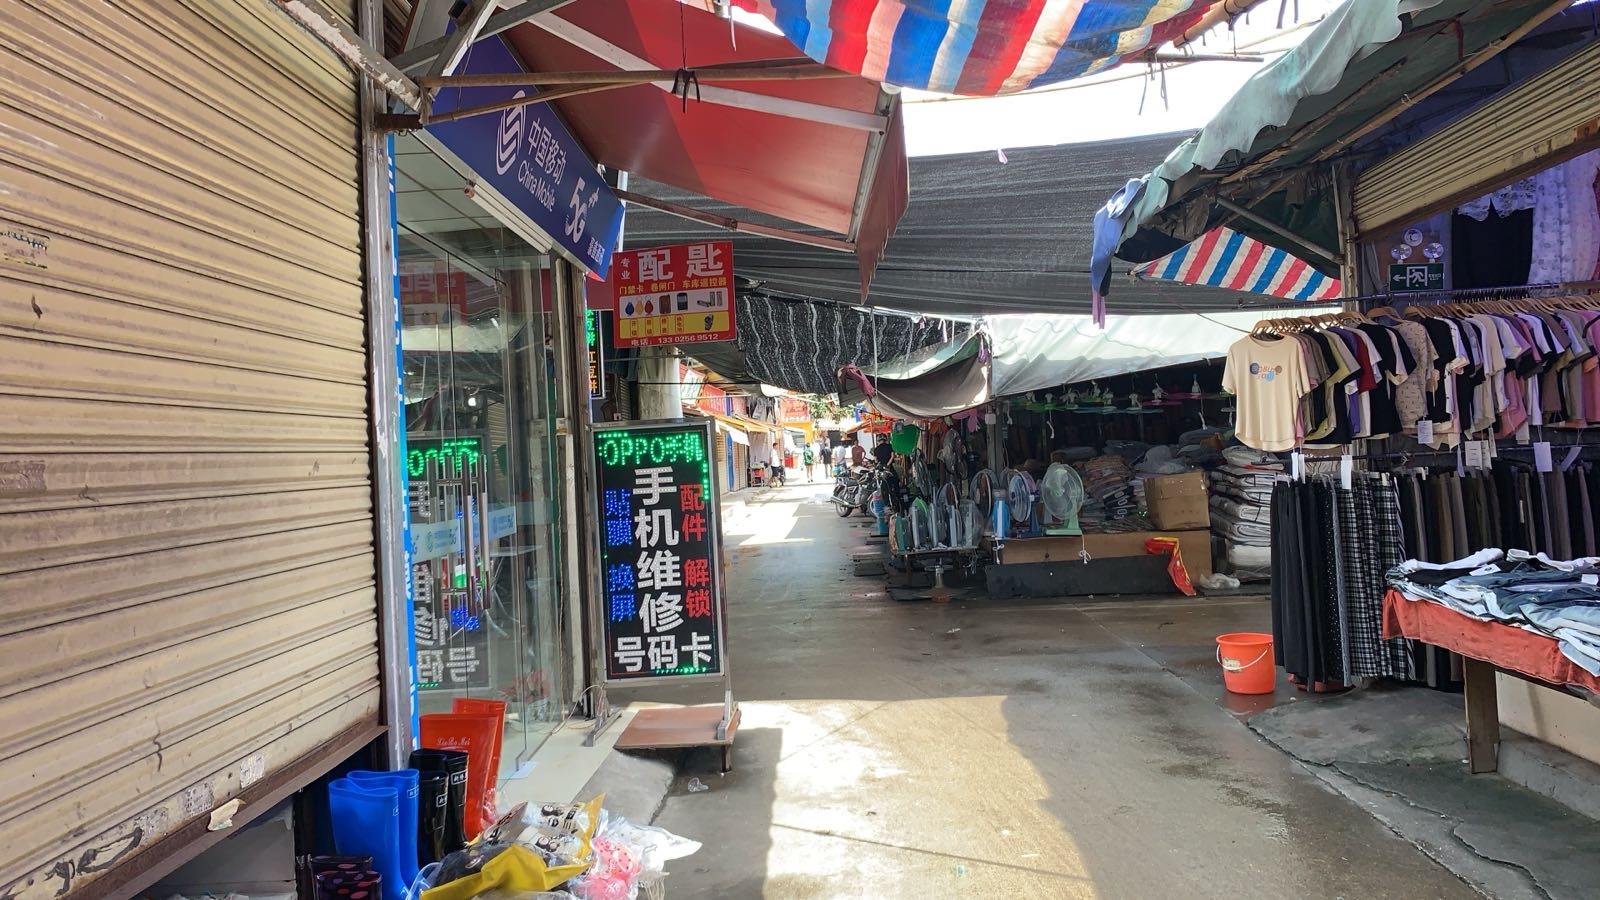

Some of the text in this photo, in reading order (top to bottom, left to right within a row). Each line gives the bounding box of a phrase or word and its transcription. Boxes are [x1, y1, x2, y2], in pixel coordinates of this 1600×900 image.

[527, 117, 567, 185] 中国移动
[518, 159, 556, 212] China Mobile
[620, 257, 631, 280] 专业
[638, 244, 724, 282] 配匙
[633, 466, 684, 633] 手机维修
[680, 484, 711, 618] 配件 解锁
[608, 564, 636, 622] 换屏
[614, 631, 712, 672] 号码卡
